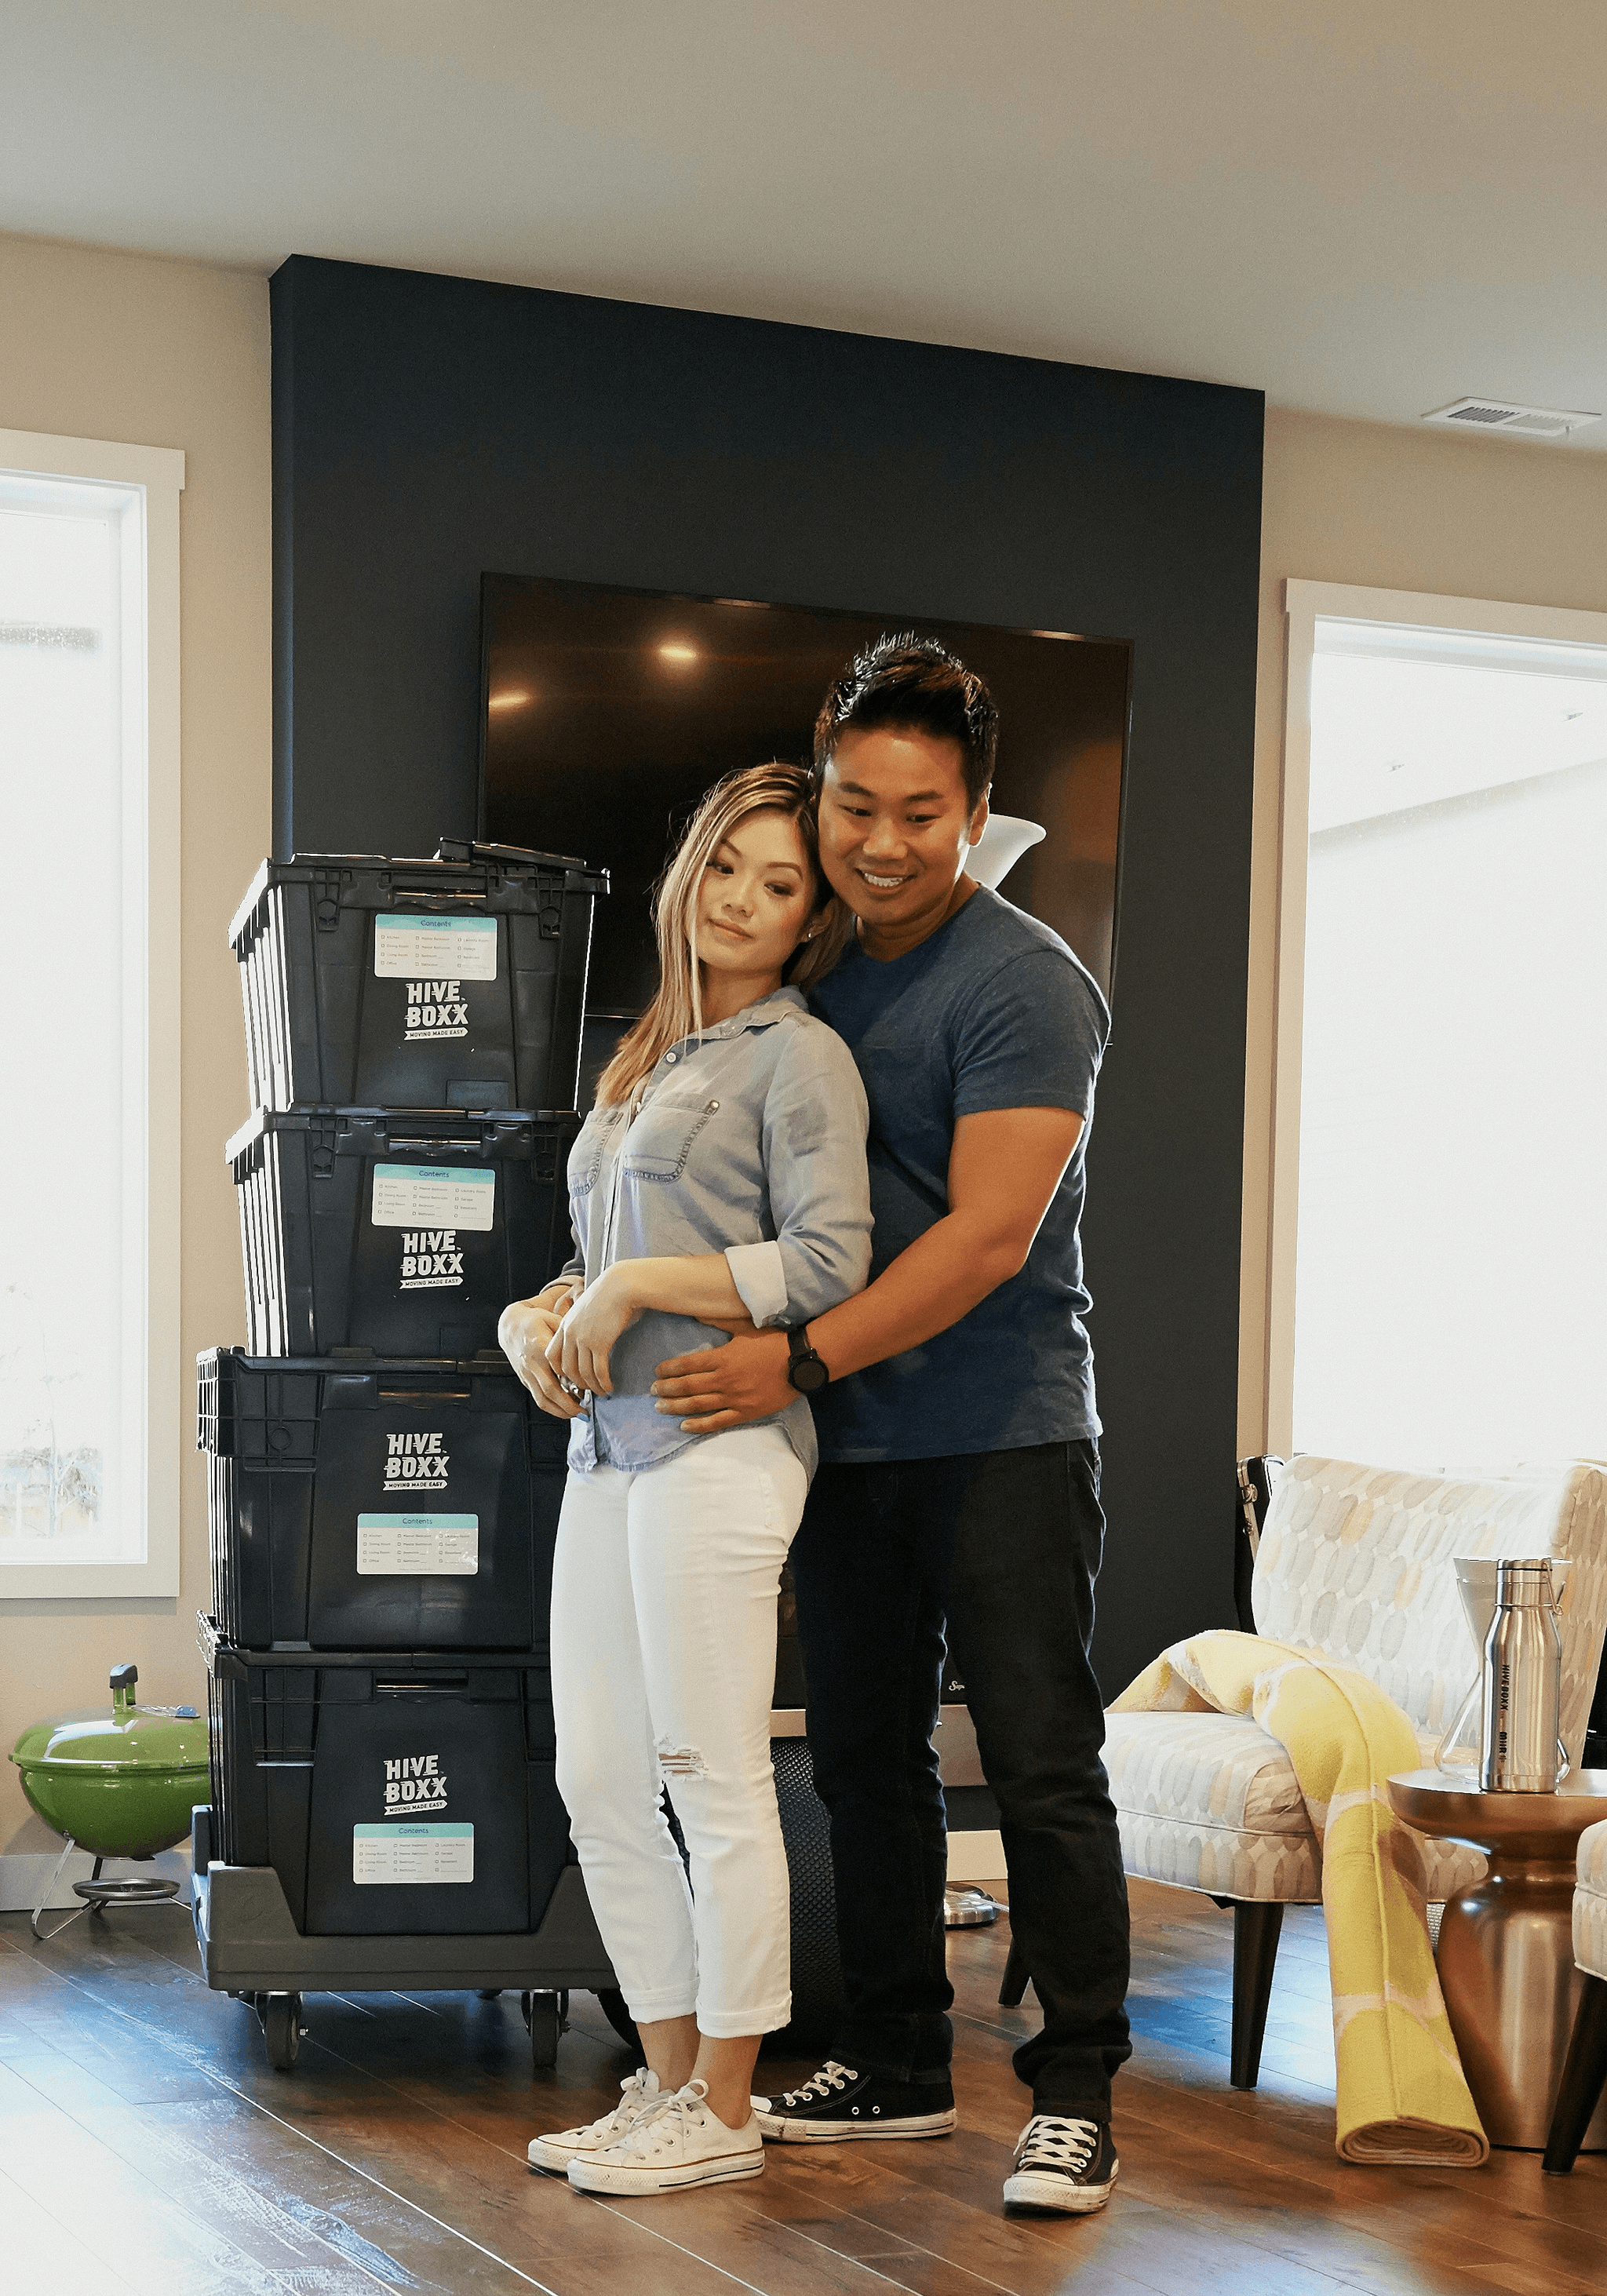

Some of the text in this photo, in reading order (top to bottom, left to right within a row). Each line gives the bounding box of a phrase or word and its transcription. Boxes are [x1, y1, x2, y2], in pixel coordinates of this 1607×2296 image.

[406, 981, 461, 1004] HIVE
[404, 1004, 468, 1028] BOXX
[401, 1230, 456, 1254] HIVE
[400, 1253, 464, 1277] BOXX
[386, 1433, 443, 1455] HIVE
[384, 1456, 450, 1478] BOXX
[383, 1755, 439, 1780] HIVE
[383, 1777, 448, 1803] BOXX
